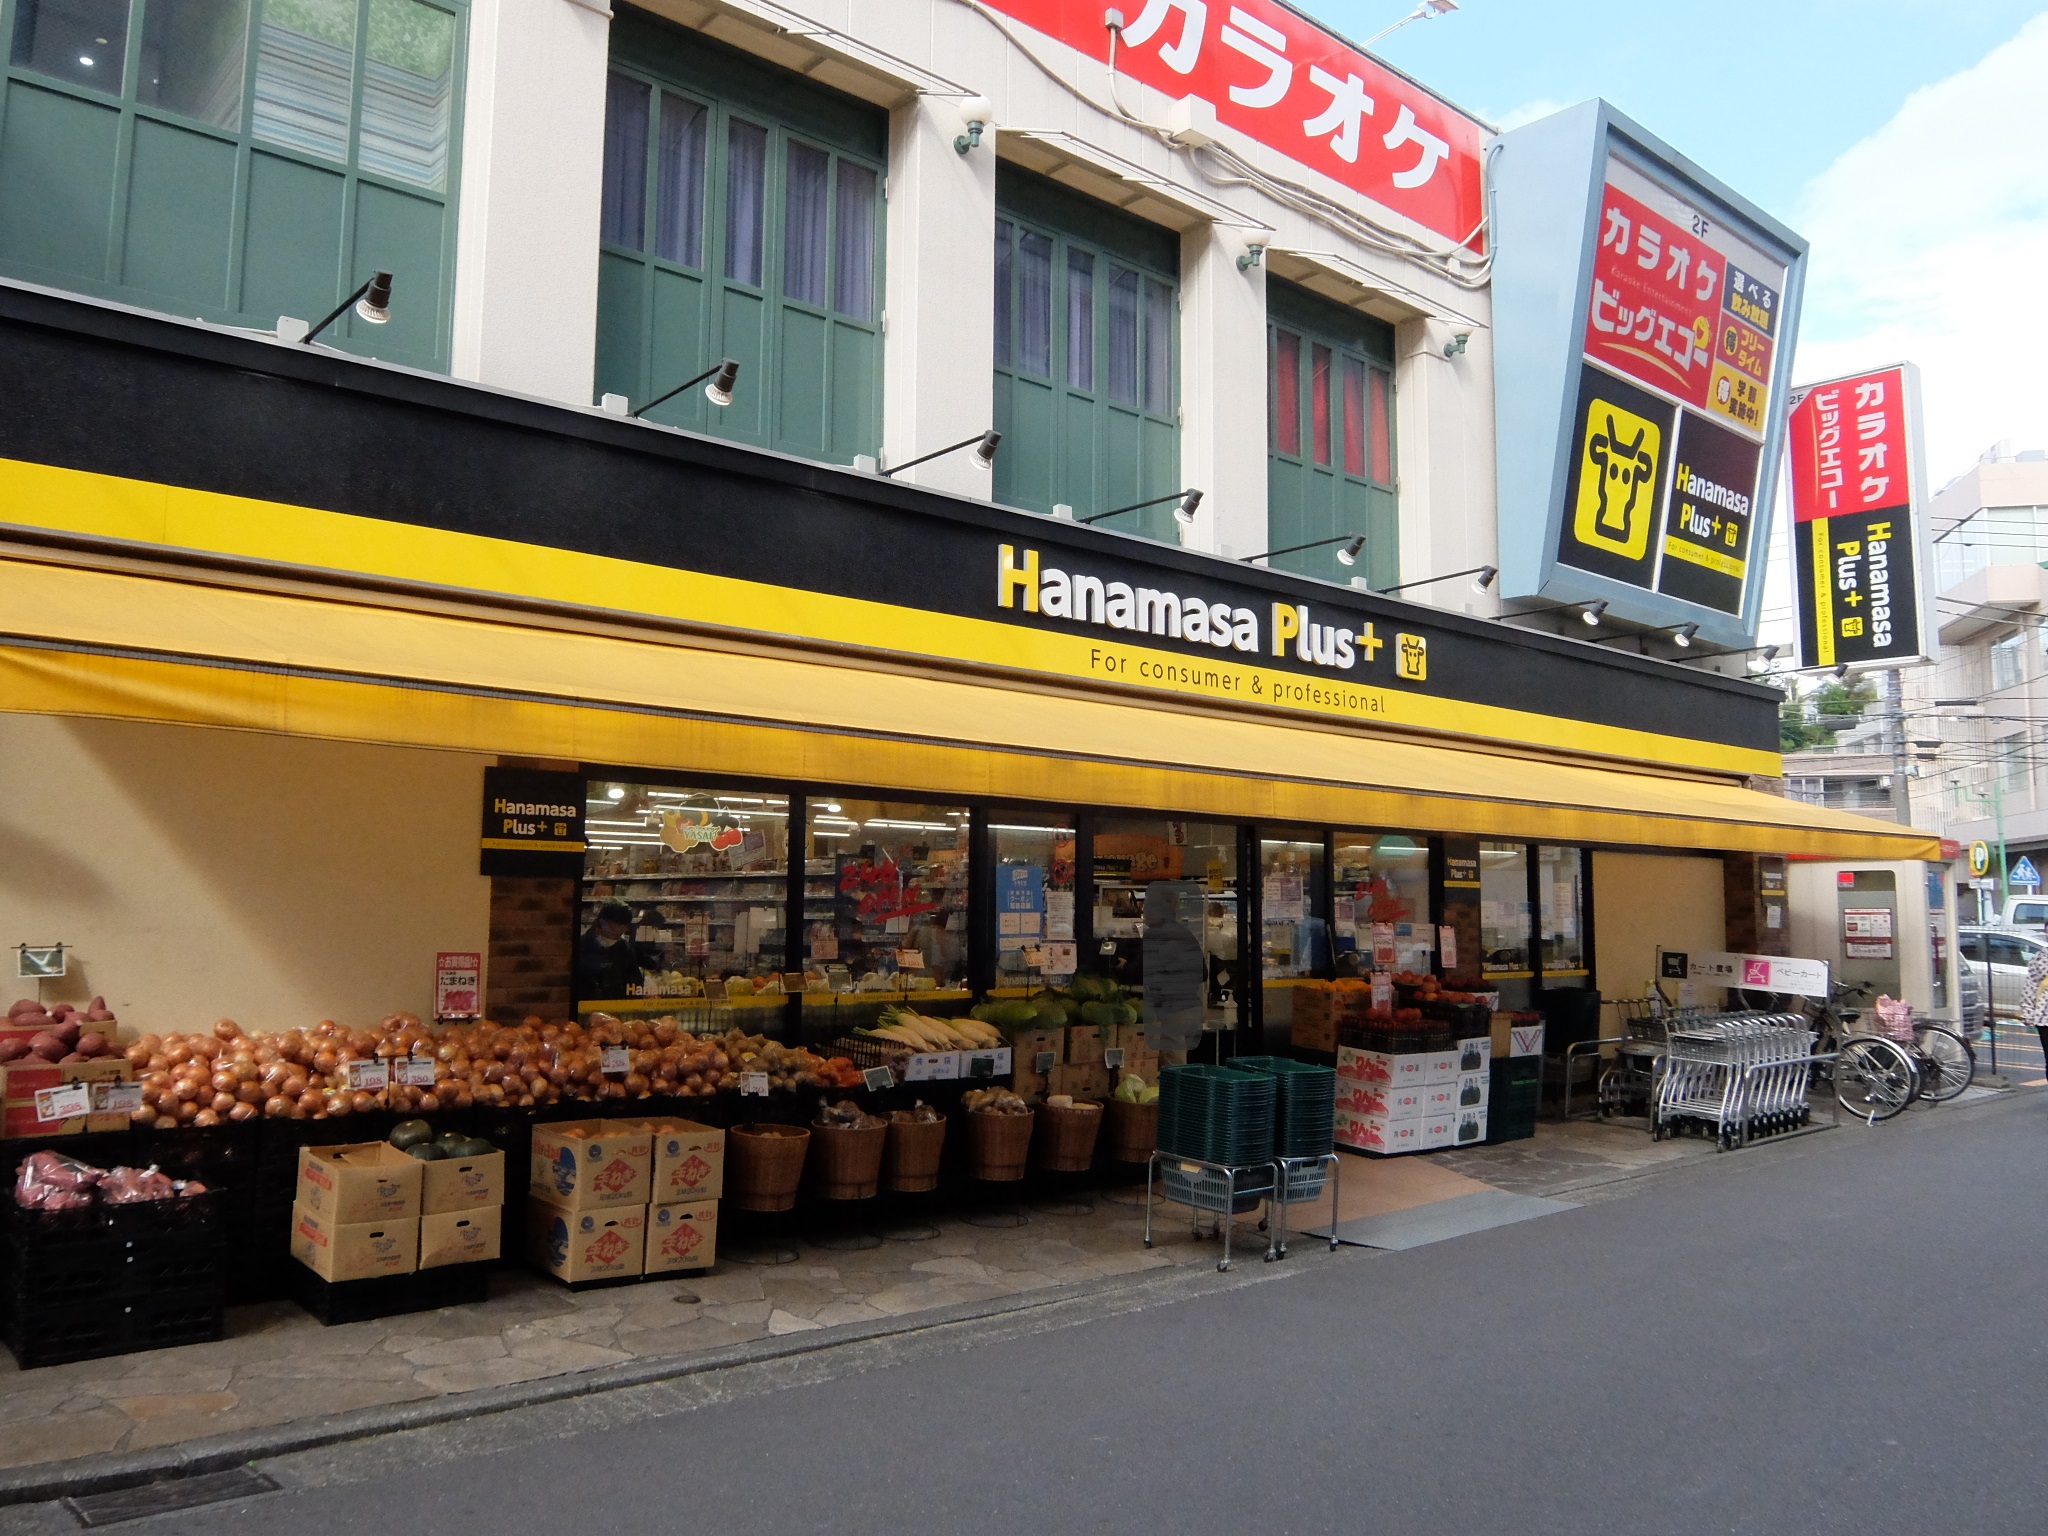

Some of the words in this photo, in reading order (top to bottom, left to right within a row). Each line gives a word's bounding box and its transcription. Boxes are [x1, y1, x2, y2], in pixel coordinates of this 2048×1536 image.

[1121, 0, 1449, 188] カラオケ
[1692, 214, 1709, 238] 2F
[1603, 207, 1717, 301] カラオケ
[1733, 270, 1772, 309] 選べる
[1591, 278, 1709, 372] ビッグエコー
[1741, 328, 1765, 352] フリー
[1738, 349, 1762, 377] タイム
[1789, 393, 1805, 405] 2F
[1815, 388, 1844, 509] ビッグエコー
[1855, 381, 1891, 504] カラオケ
[1676, 462, 1749, 516] Hanamasa
[1818, 546, 1826, 589] consumer
[1867, 521, 1892, 648] Hanamasa
[998, 543, 1259, 654] Hanamasa
[1820, 600, 1830, 654] professional
[1090, 648, 1127, 674] For
[1140, 660, 1241, 693] consumer
[1252, 675, 1264, 695] &
[1273, 680, 1386, 714] professional
[494, 798, 577, 818] Hanamasa
[1975, 847, 1985, 870] P
[440, 976, 475, 986] たまねぎ
[1689, 963, 1733, 974] カート置場
[1775, 968, 1822, 979] ベビーカート
